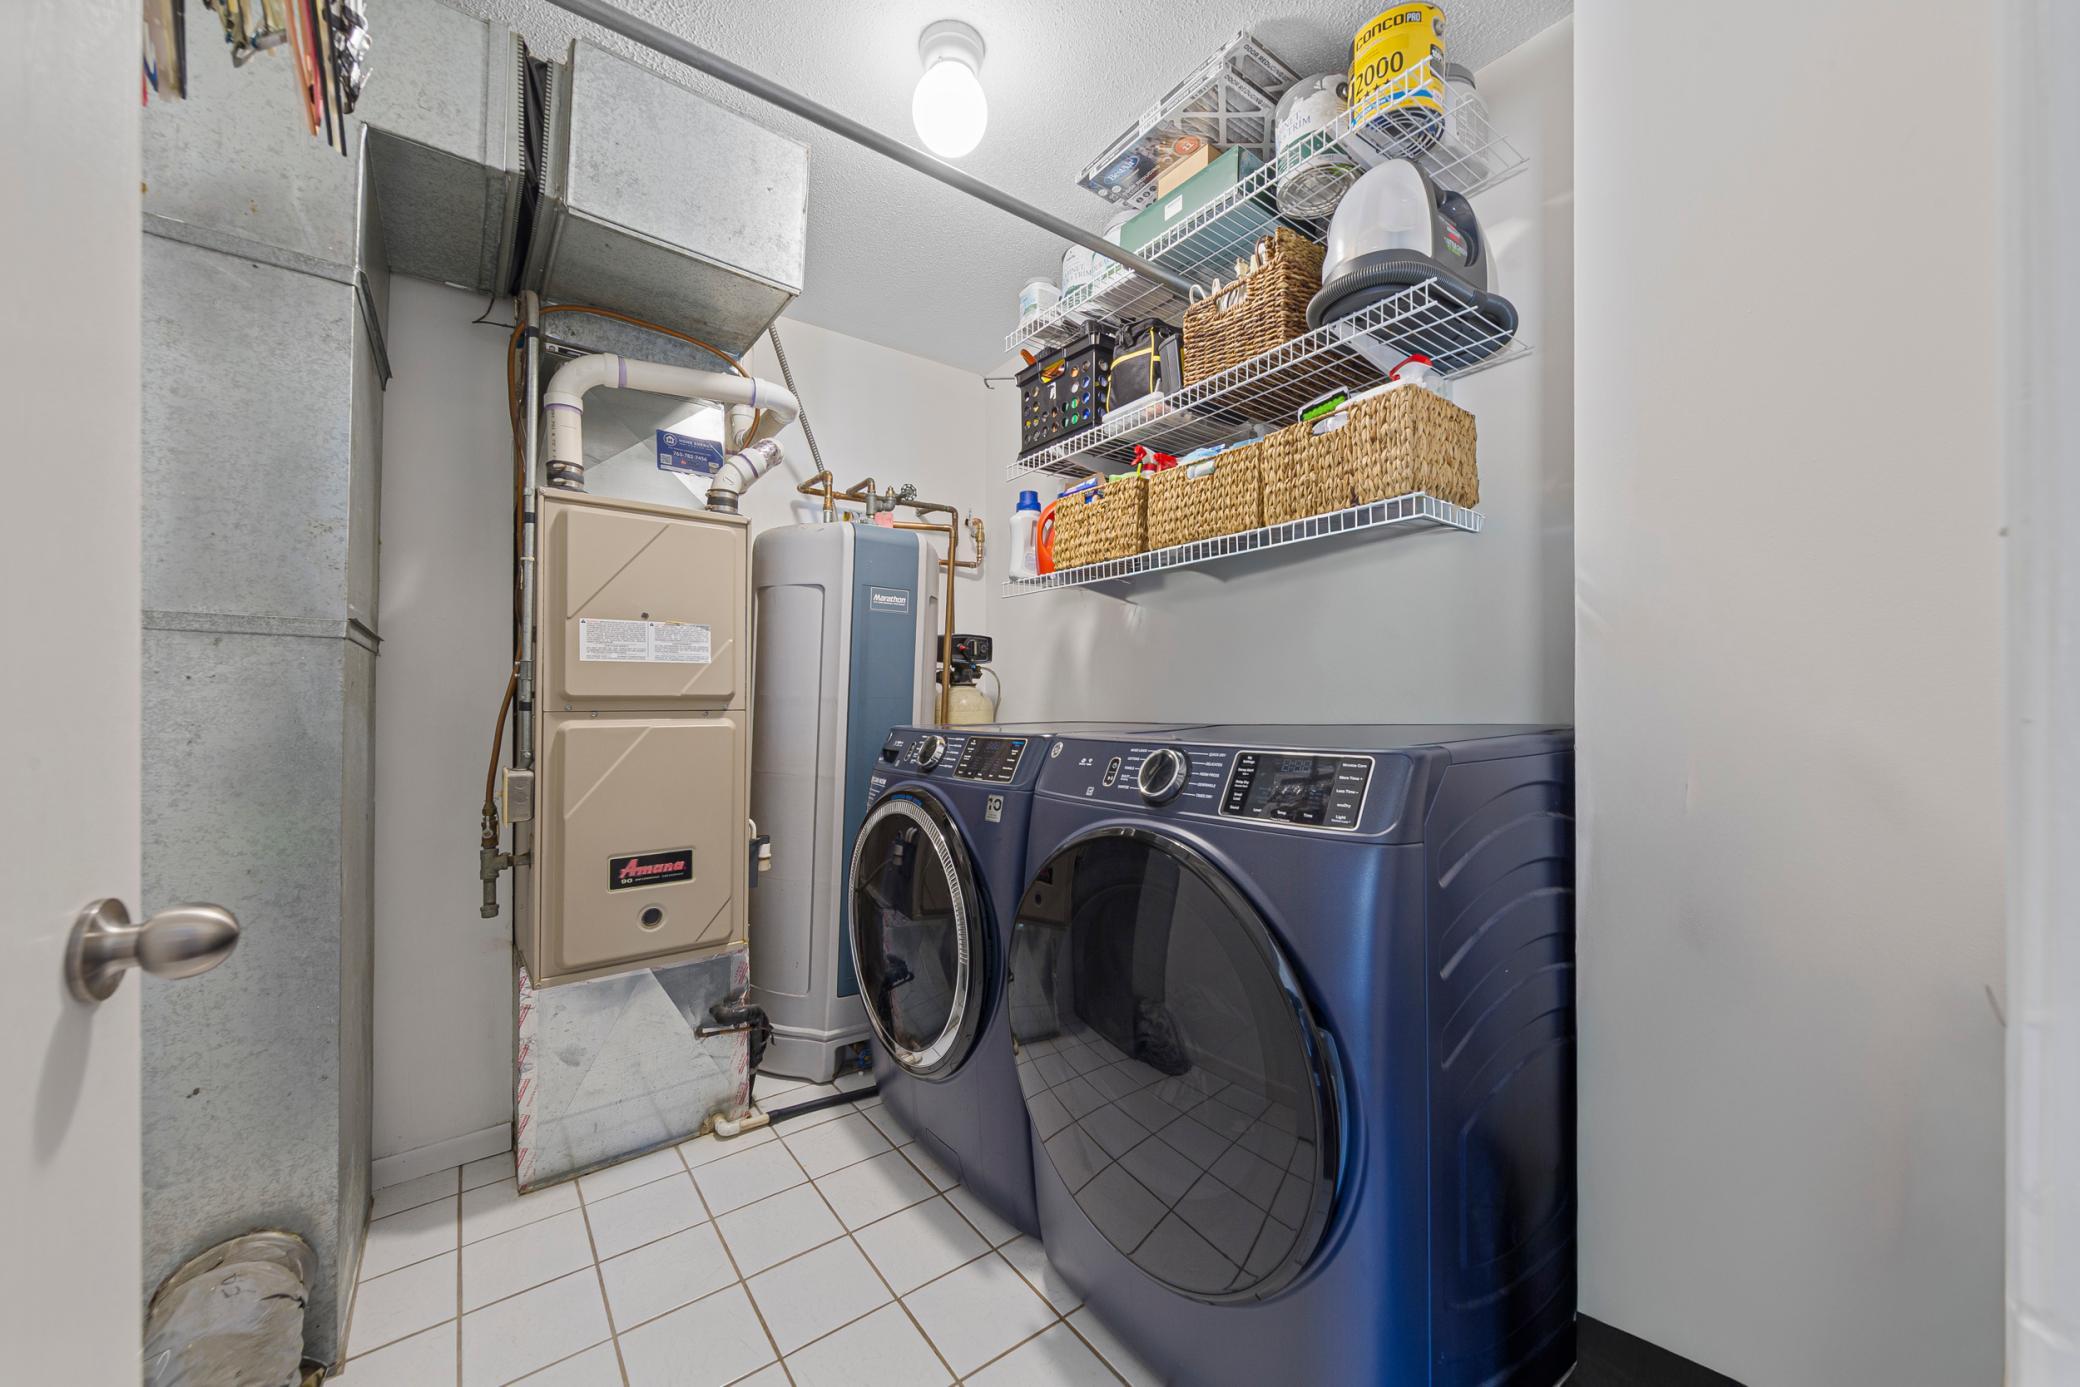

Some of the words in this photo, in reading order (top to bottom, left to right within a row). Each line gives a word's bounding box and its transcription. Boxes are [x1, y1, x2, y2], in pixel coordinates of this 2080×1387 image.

[1406, 12, 1420, 22] PRO
[1356, 51, 1404, 96] 2000
[873, 594, 906, 603] Marathon
[989, 798, 1002, 811] 10
[620, 858, 685, 878] Amana
